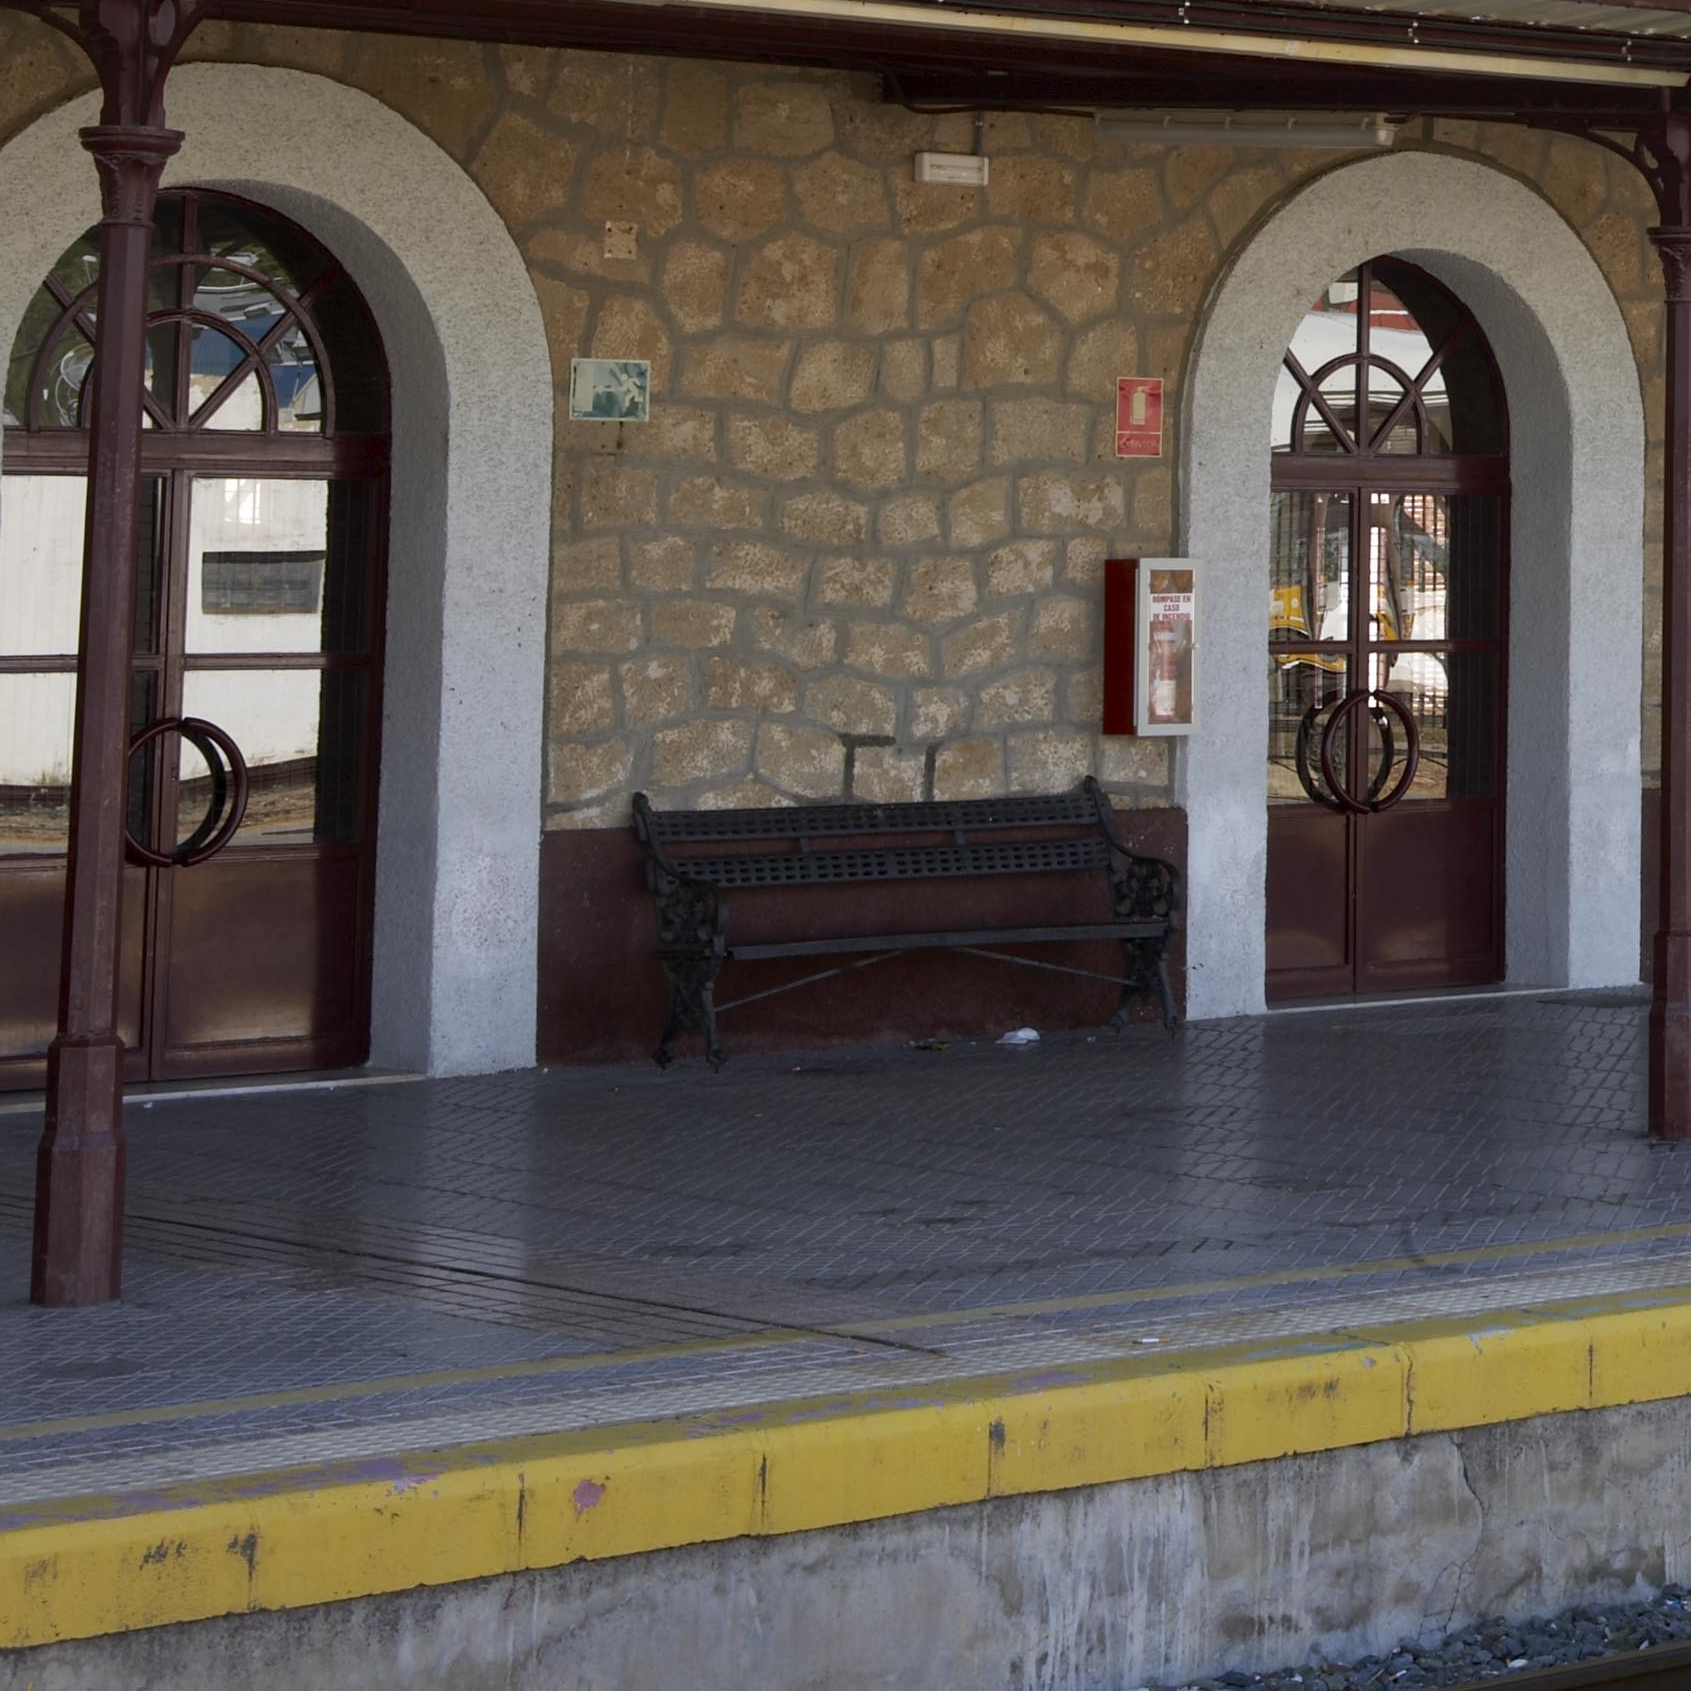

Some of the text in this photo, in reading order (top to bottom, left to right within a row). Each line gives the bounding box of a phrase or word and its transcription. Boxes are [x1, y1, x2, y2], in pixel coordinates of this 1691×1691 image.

[1182, 594, 1191, 603] EN
[1163, 604, 1180, 612] CASO
[1153, 613, 1160, 621] DE
